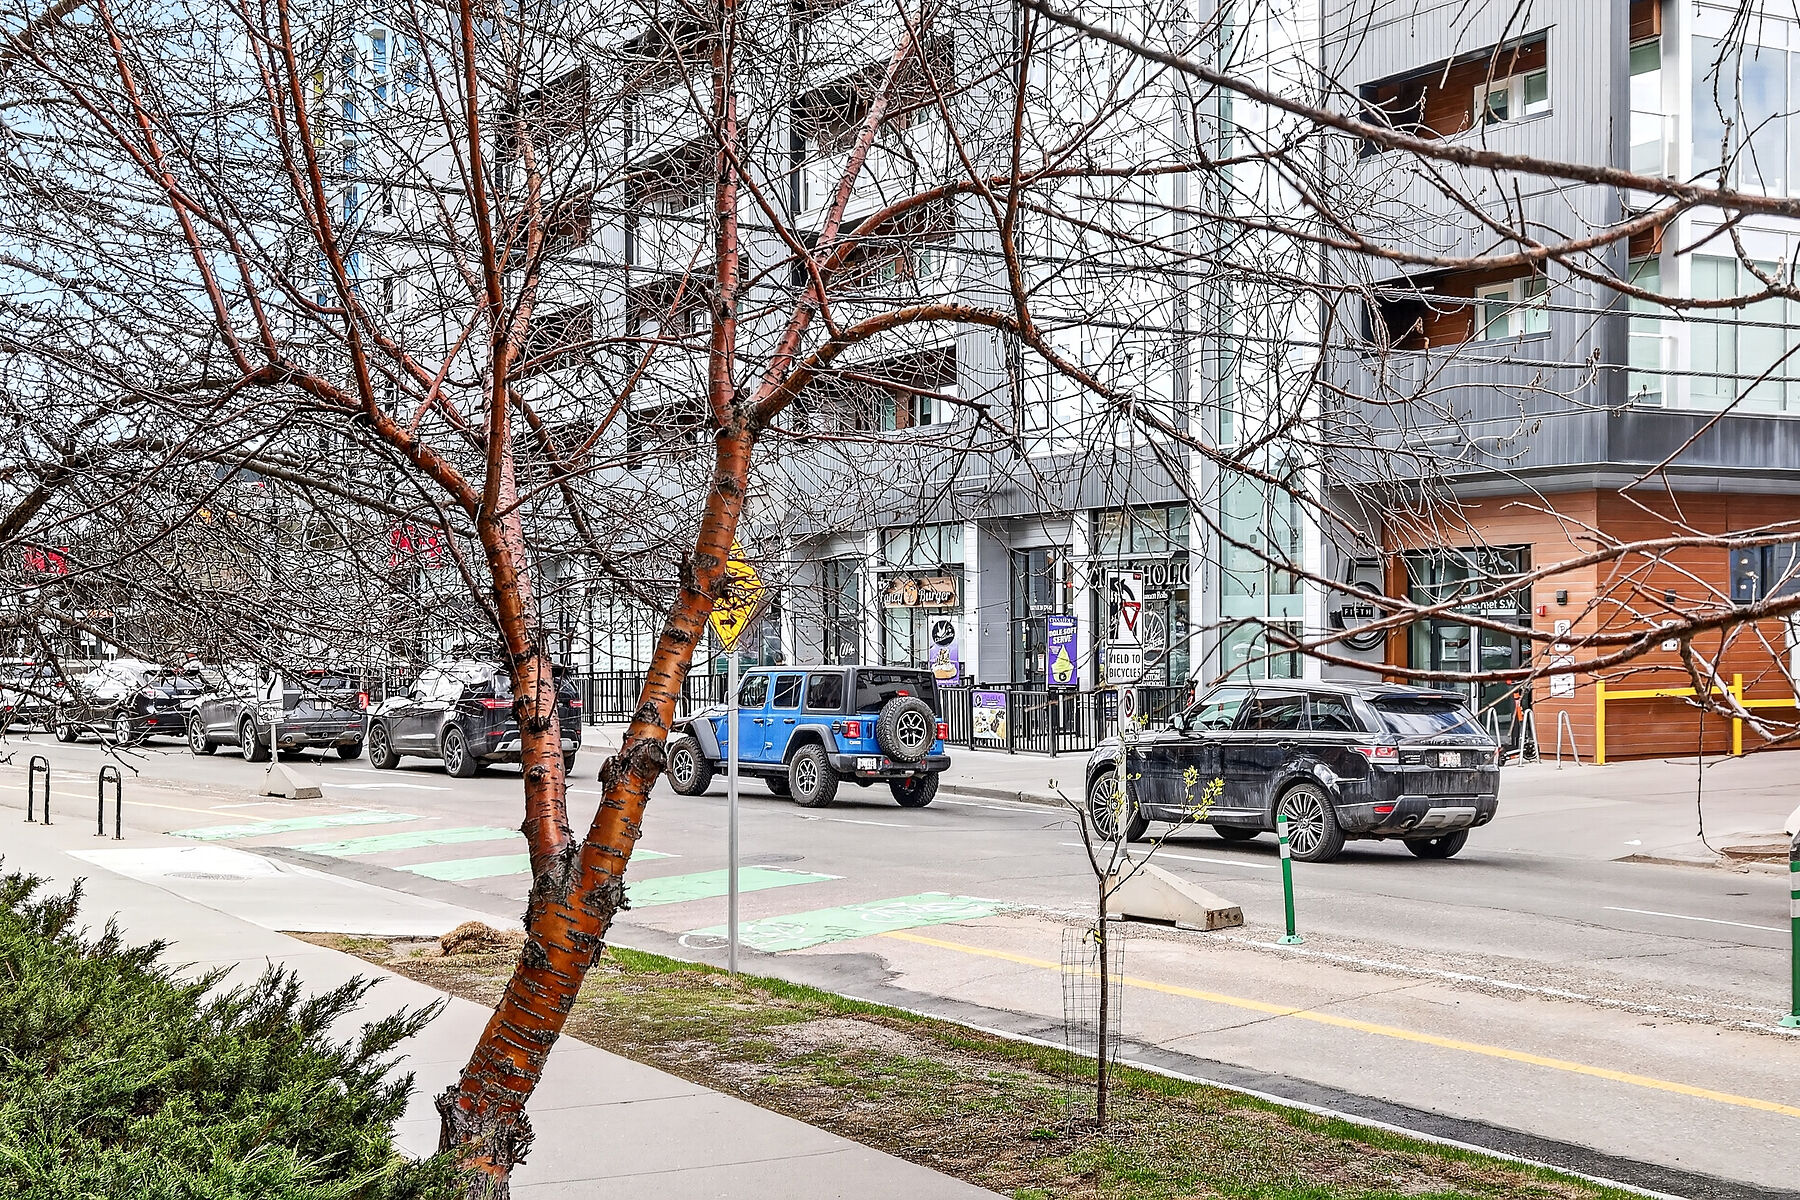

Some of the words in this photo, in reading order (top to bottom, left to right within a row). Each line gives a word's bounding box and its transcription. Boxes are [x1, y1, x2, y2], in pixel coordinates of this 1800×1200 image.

[919, 589, 951, 604] Burger
[1063, 627, 1077, 635] SOFT
[1052, 635, 1072, 644] SERVE
[1109, 654, 1129, 664] YIELD
[1132, 654, 1140, 664] TO
[1109, 668, 1140, 678] BICYCLES
